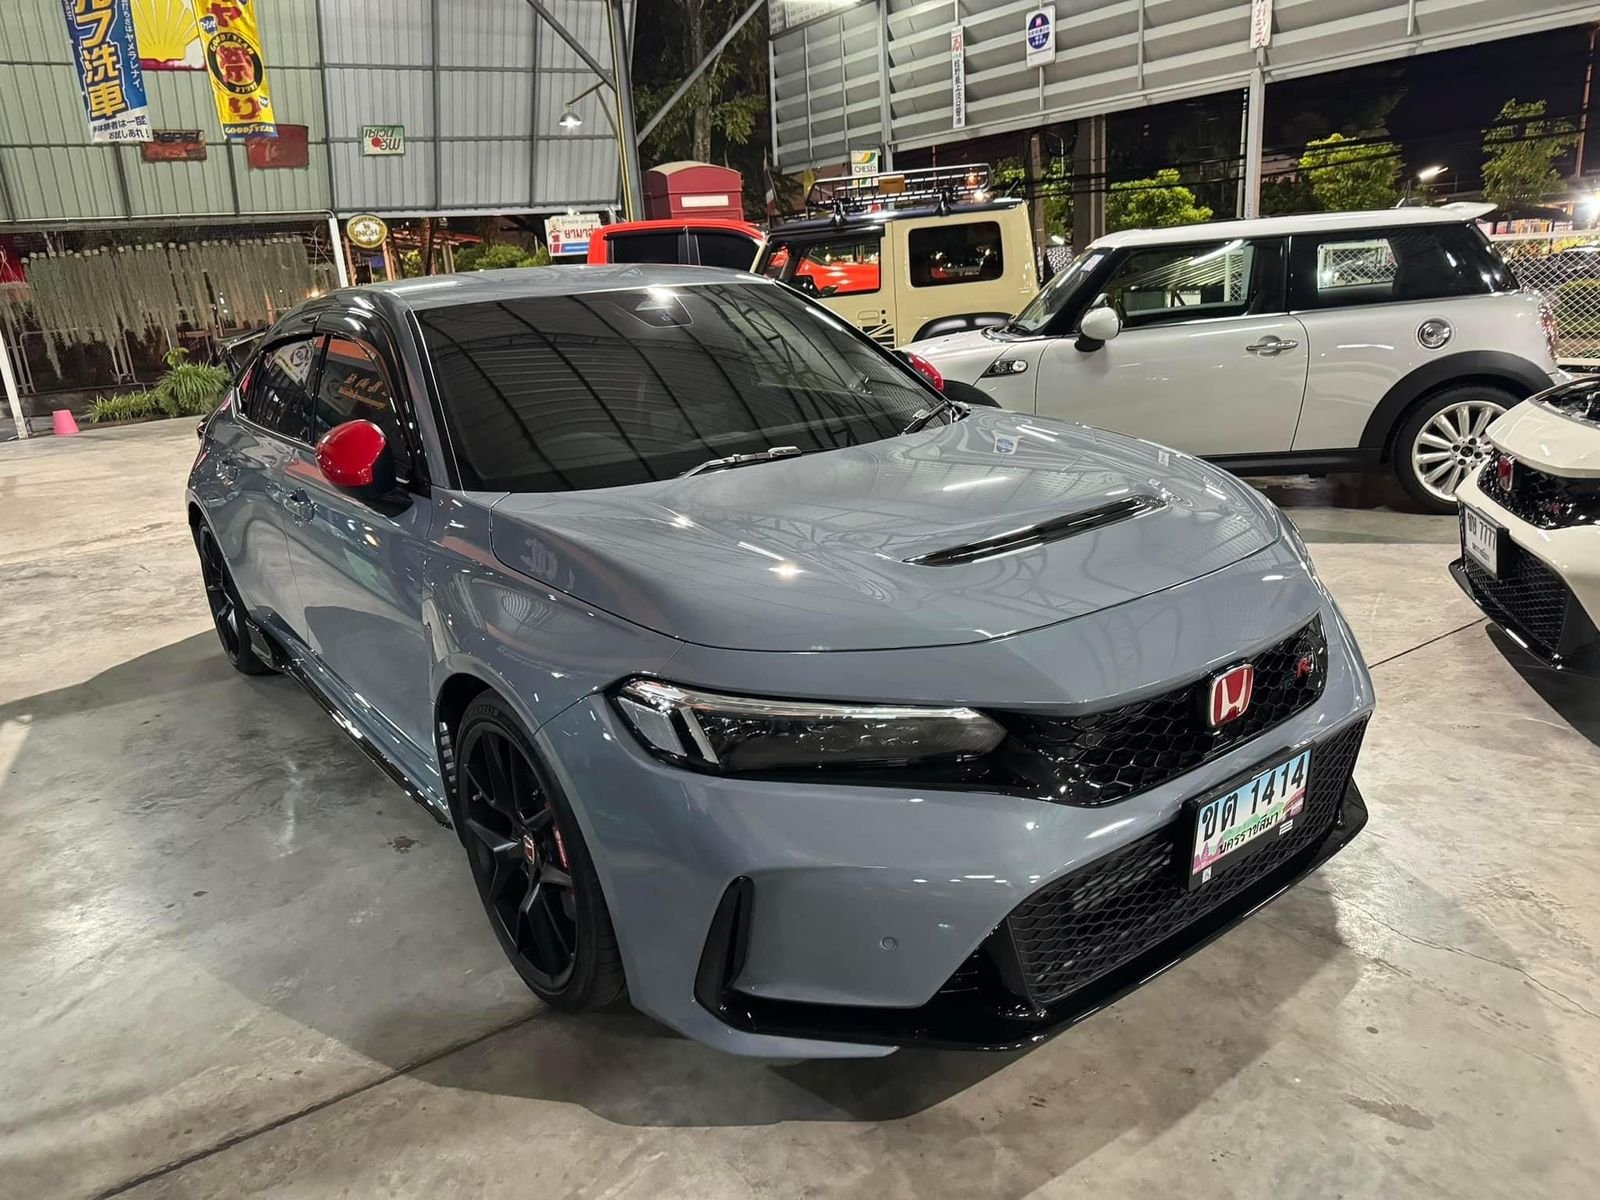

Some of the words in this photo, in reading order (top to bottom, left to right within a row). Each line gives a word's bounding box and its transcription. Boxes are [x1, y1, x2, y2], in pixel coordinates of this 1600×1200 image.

[224, 124, 274, 135] GOODYEAR
[1479, 521, 1496, 551] 7777
[1251, 754, 1306, 815] 1414
[1219, 811, 1279, 854] นครราชสีมา
